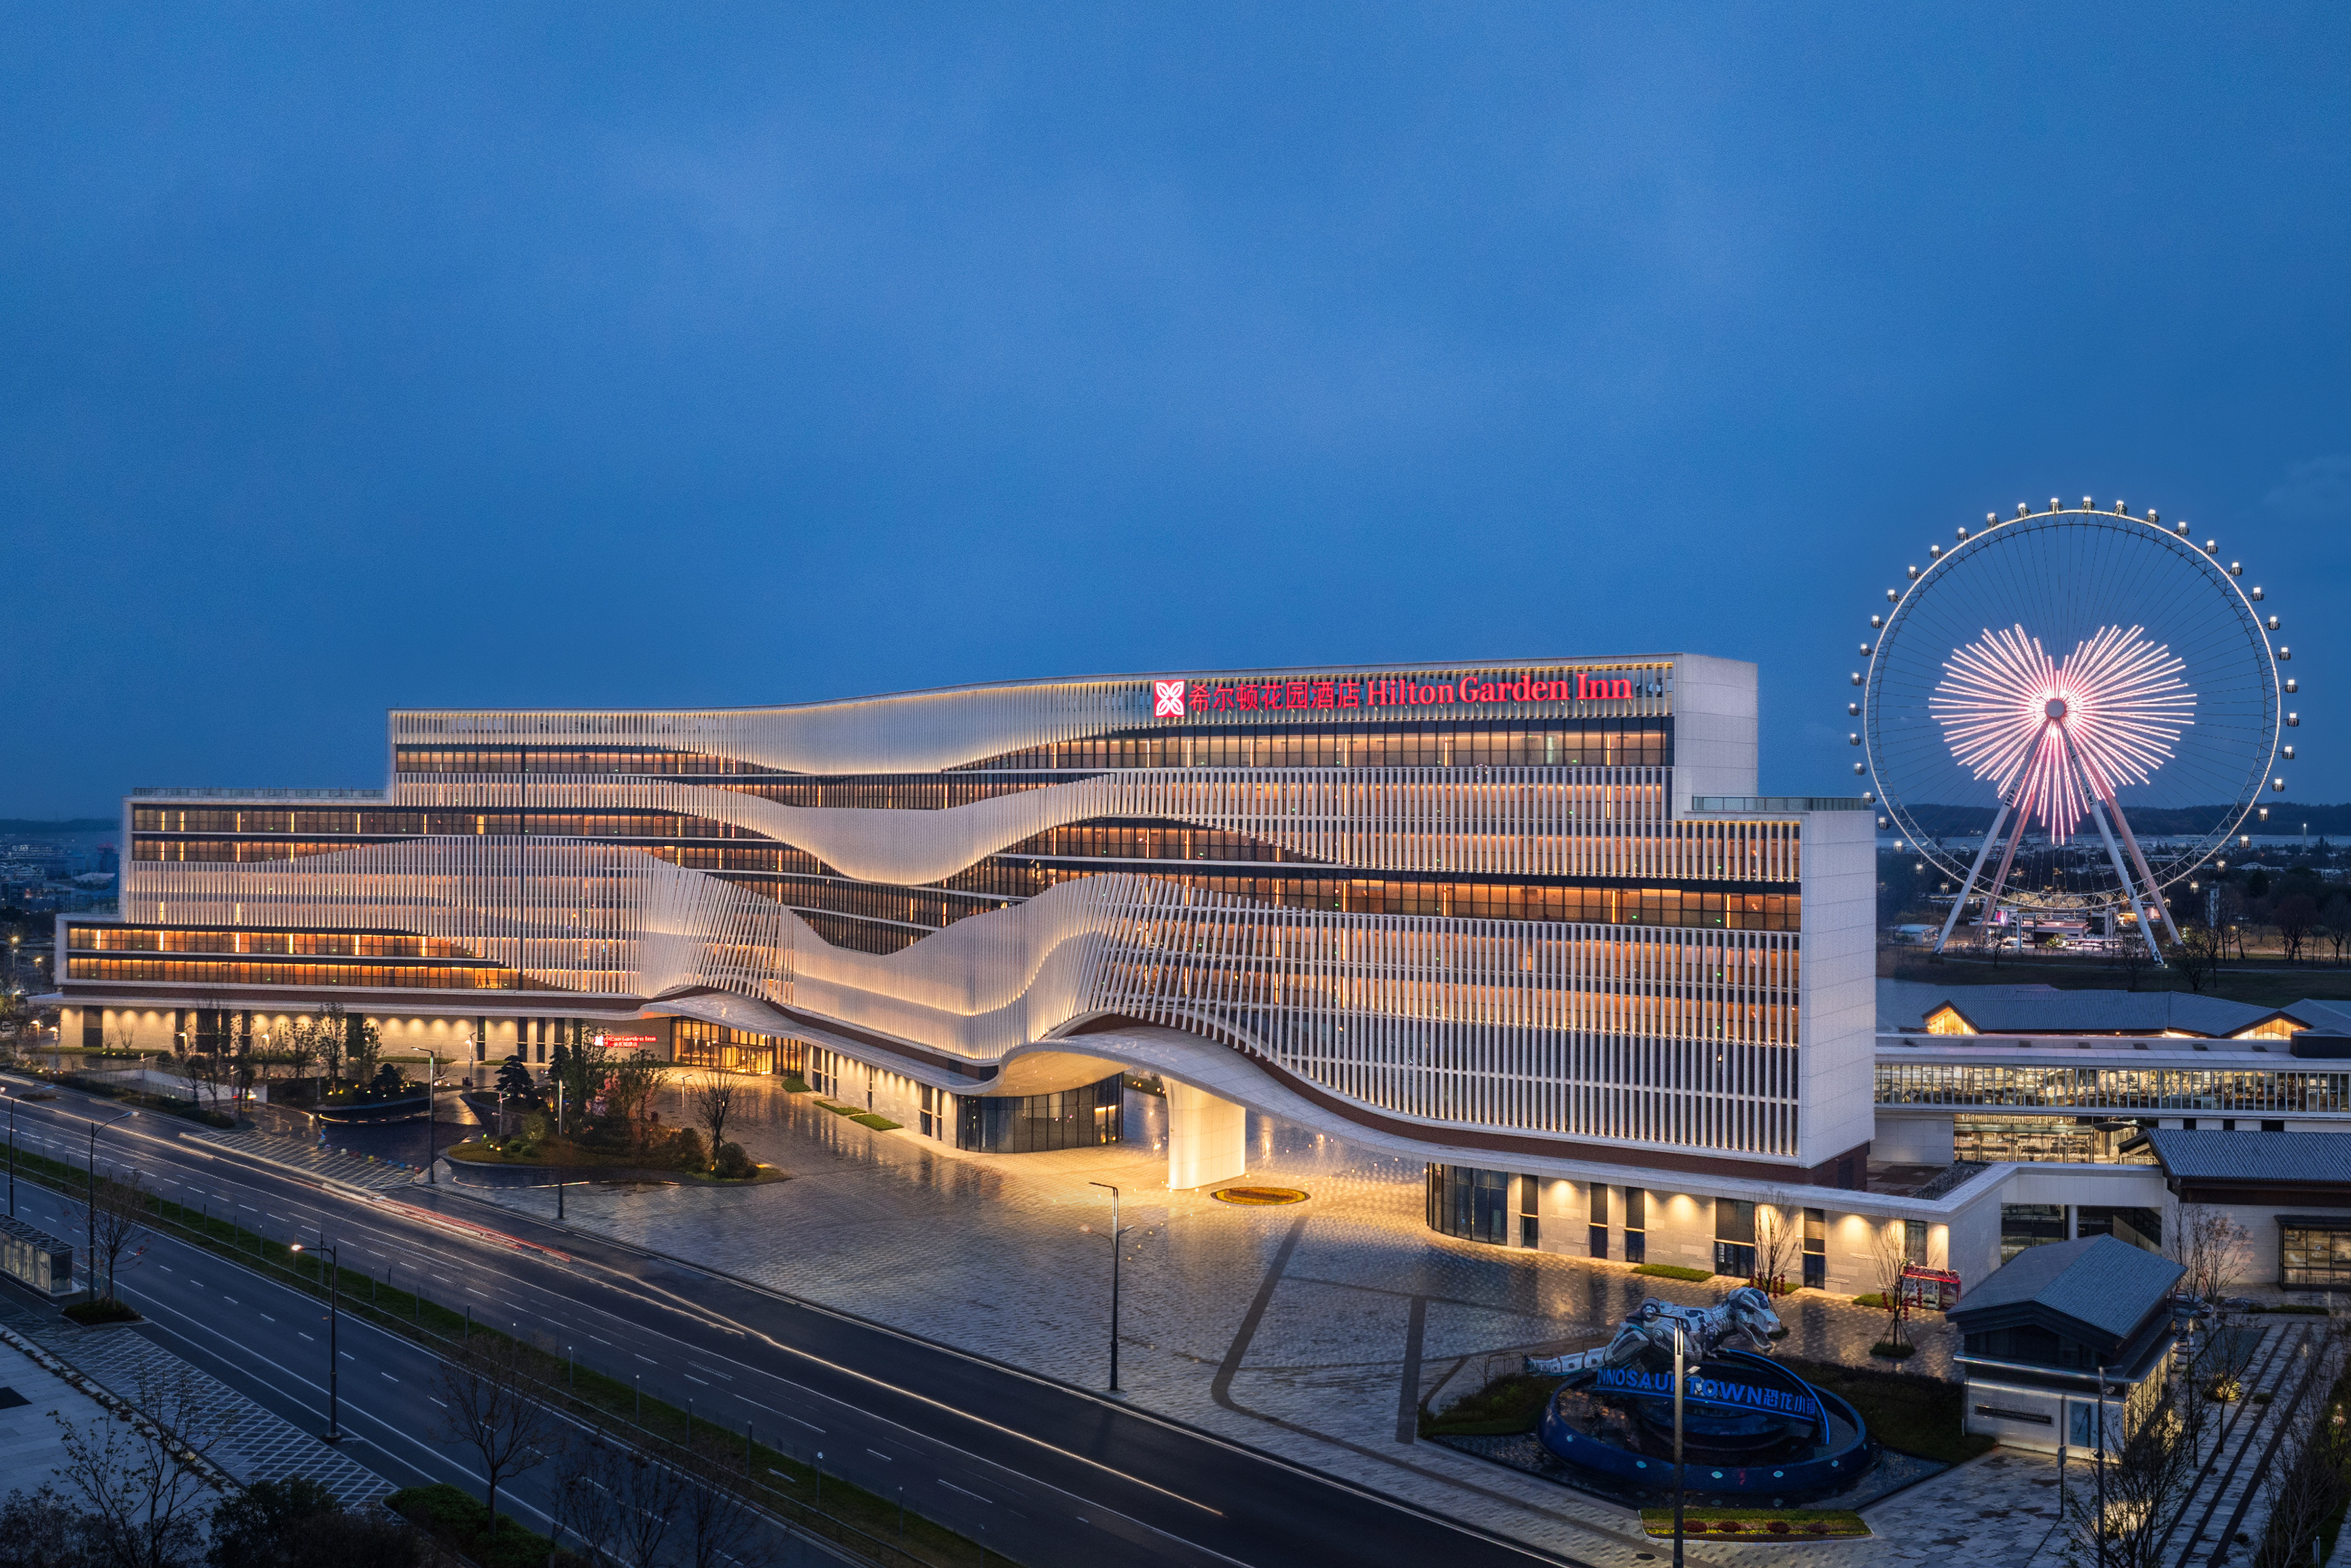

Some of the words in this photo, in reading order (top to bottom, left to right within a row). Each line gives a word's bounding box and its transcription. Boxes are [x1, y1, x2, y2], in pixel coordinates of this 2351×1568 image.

[1188, 679, 1361, 713] 希尔顿花园酒店
[1367, 679, 1455, 706] Hilton
[1458, 674, 1570, 703] Garden
[1575, 673, 1634, 700] Inn
[1686, 1377, 1763, 1405] TOWN
